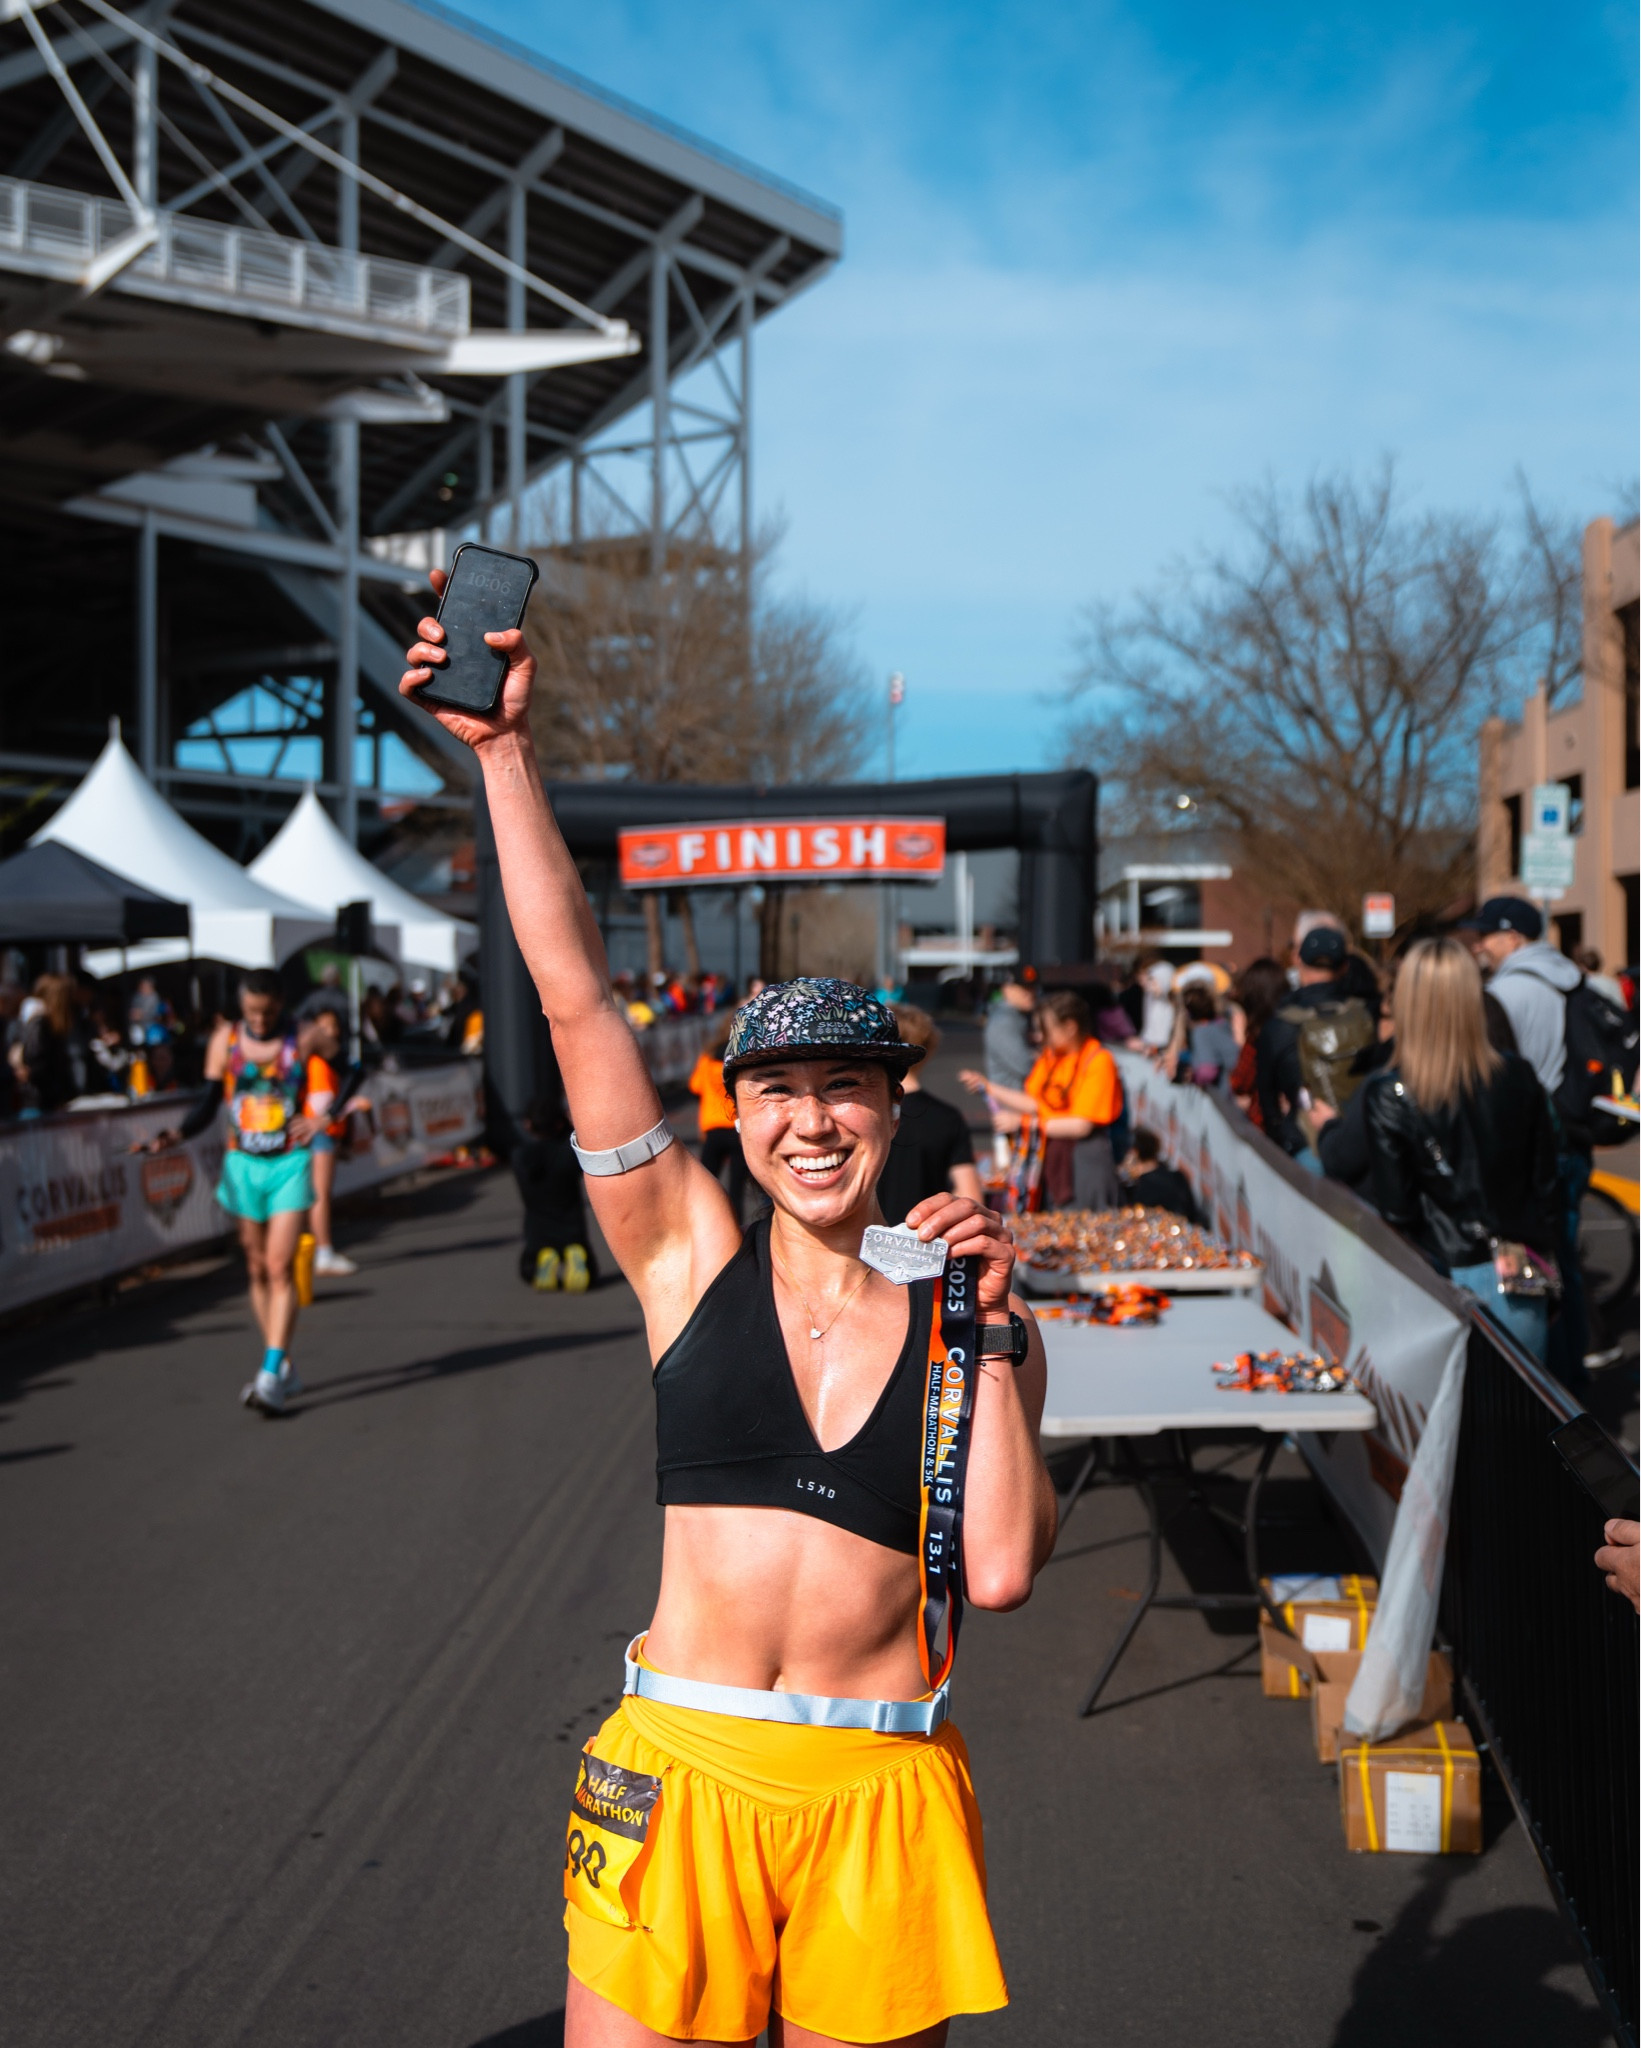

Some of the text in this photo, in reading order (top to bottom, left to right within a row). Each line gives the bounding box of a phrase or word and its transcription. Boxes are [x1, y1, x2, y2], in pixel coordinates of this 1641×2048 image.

[467, 572, 512, 594] 10:06
[678, 828, 885, 872] FINISH
[817, 1021, 851, 1029] SKIDA
[865, 1231, 947, 1256] CORVALLIS
[948, 1258, 966, 1312] 2025
[924, 1365, 942, 1484] HALF-MARATHON & 5K
[935, 1347, 966, 1503] CORVALLIS
[929, 1531, 943, 1574] 13.1
[576, 1786, 645, 1827] MARATHON
[588, 1775, 628, 1801] HALF
[565, 1829, 606, 1888] 90
